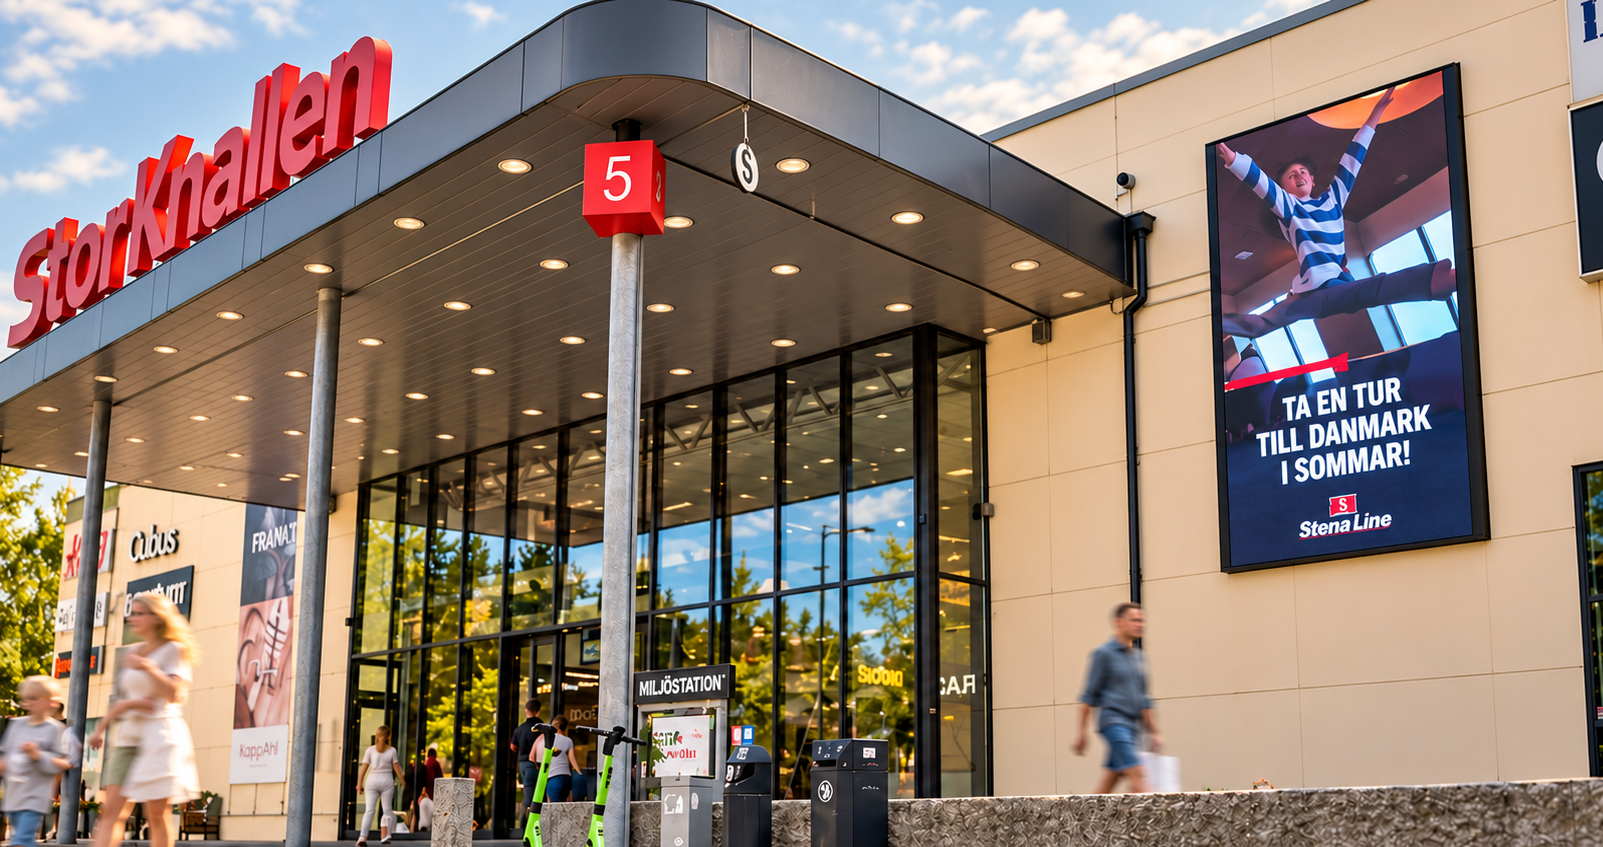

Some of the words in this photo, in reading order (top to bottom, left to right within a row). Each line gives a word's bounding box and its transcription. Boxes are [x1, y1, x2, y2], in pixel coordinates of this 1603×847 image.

[603, 155, 632, 202] 5
[742, 149, 753, 184] S
[7, 36, 393, 348] StorKnallen
[1282, 394, 1311, 422] TA
[1317, 388, 1347, 415] EN
[1352, 377, 1402, 409] TUR
[1256, 427, 1304, 457] TILL
[1309, 404, 1432, 449] DANMARK
[1281, 460, 1289, 485] I
[1294, 440, 1411, 483] SOMMAR!
[1299, 518, 1350, 538] Stena
[1353, 512, 1392, 531] Line
[1339, 498, 1348, 512] S
[129, 524, 179, 563] Cubus
[239, 740, 279, 762] KappAhl
